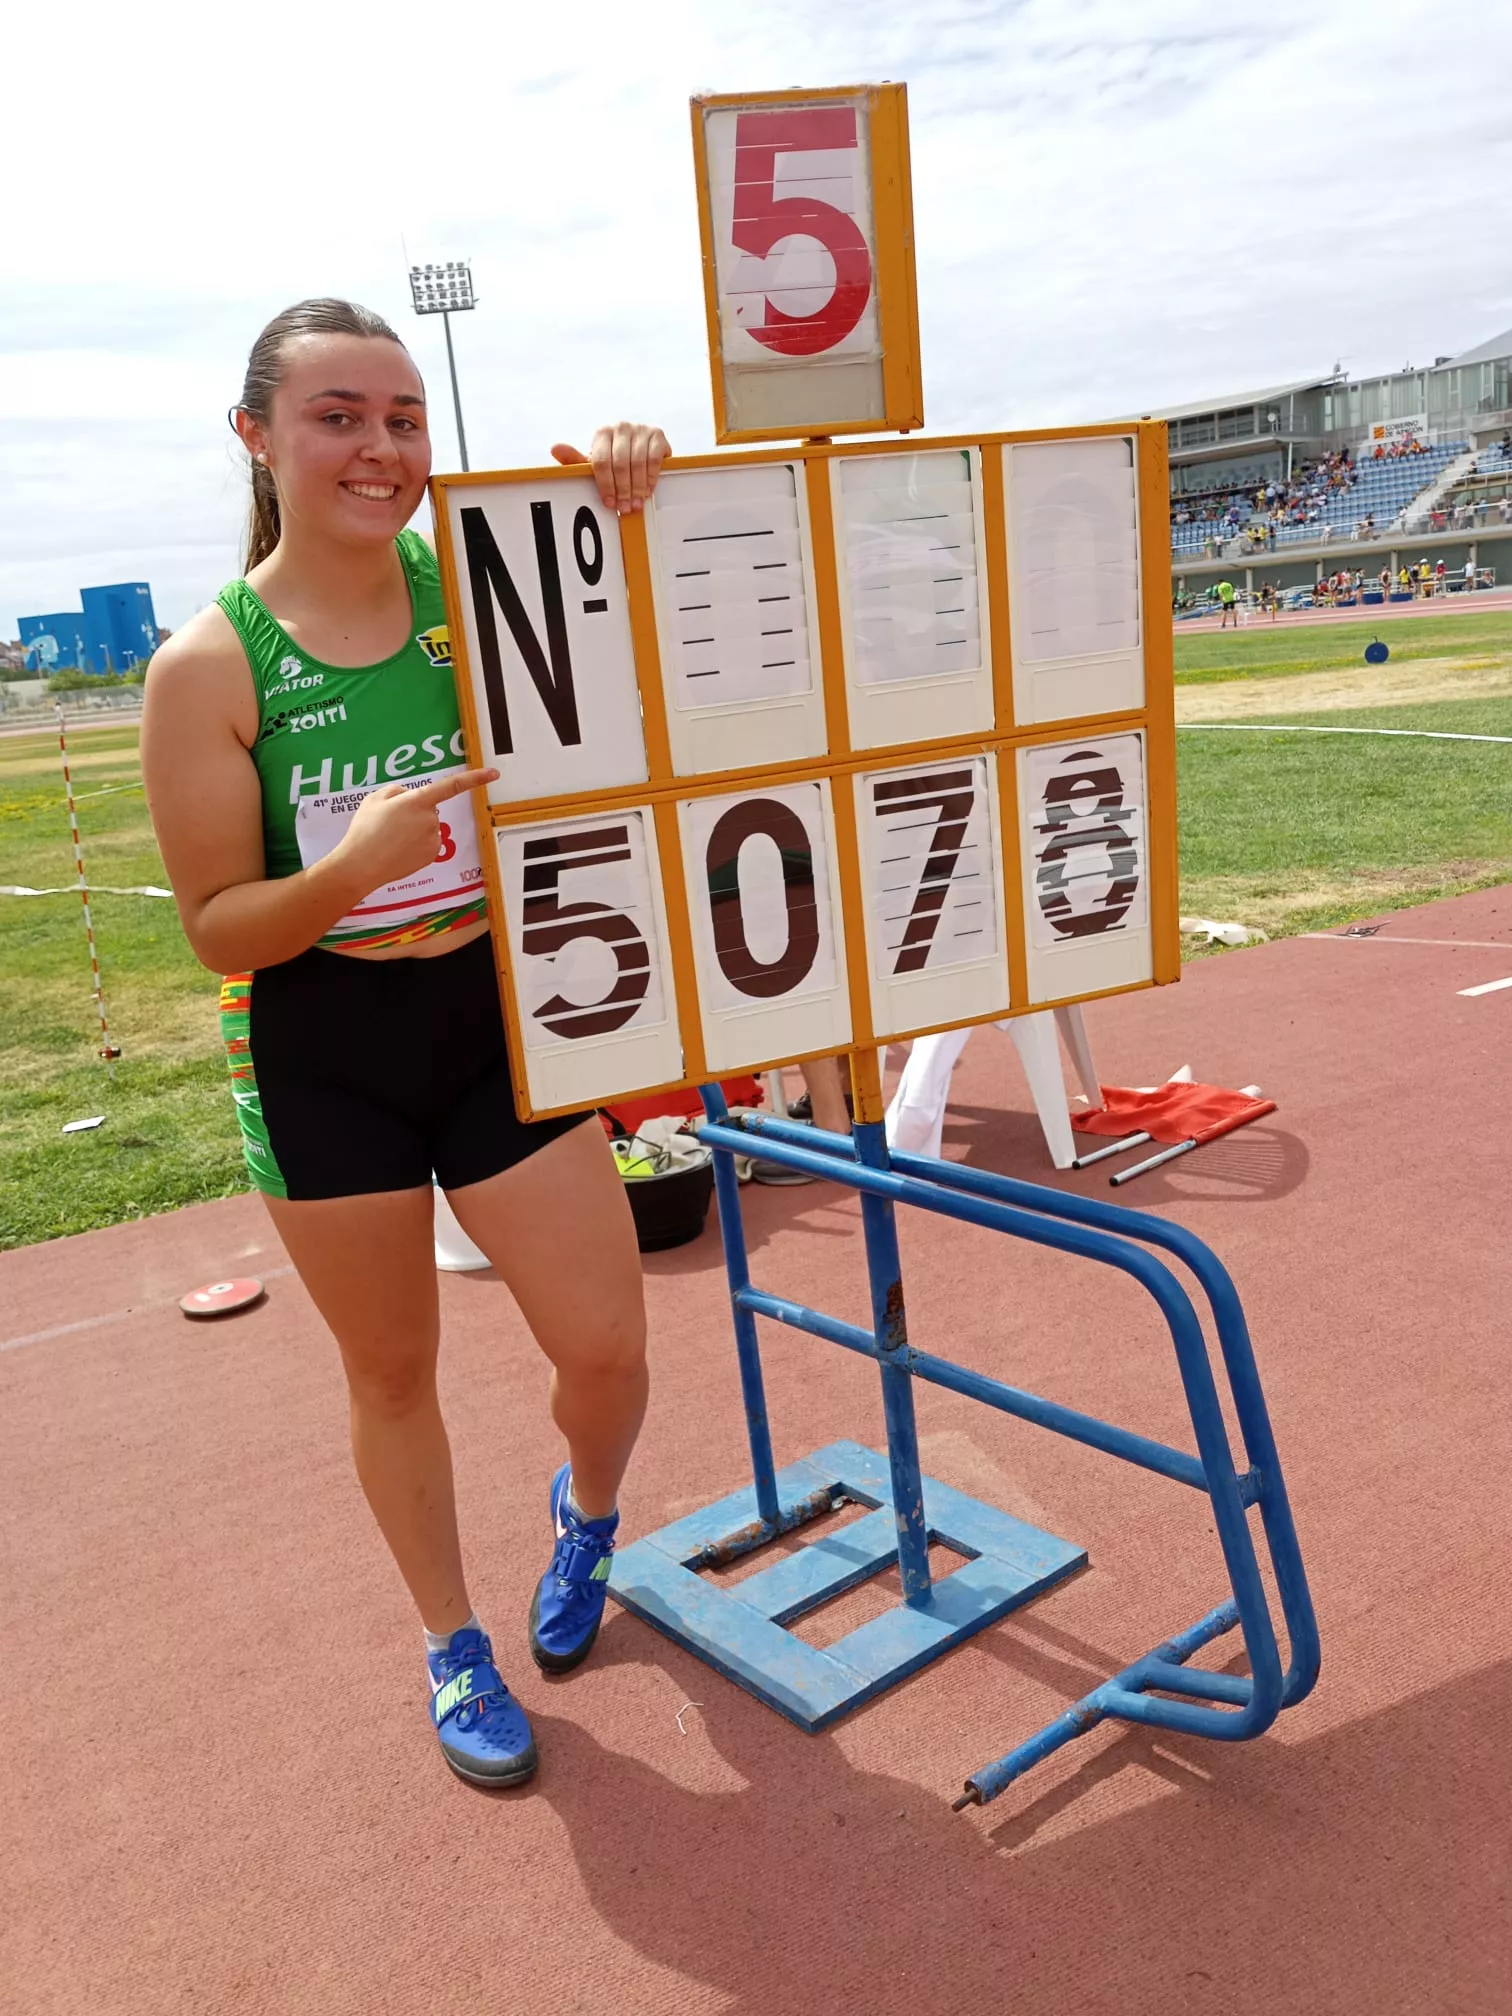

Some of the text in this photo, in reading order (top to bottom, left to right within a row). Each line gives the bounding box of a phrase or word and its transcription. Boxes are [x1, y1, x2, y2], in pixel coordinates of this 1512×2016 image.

[731, 107, 871, 356] 5
[264, 674, 324, 700] VIATOR
[287, 696, 344, 717] ATLETISMO
[289, 704, 347, 733] ZOITI
[330, 806, 345, 814] EN
[436, 1669, 473, 1721] NIKE
